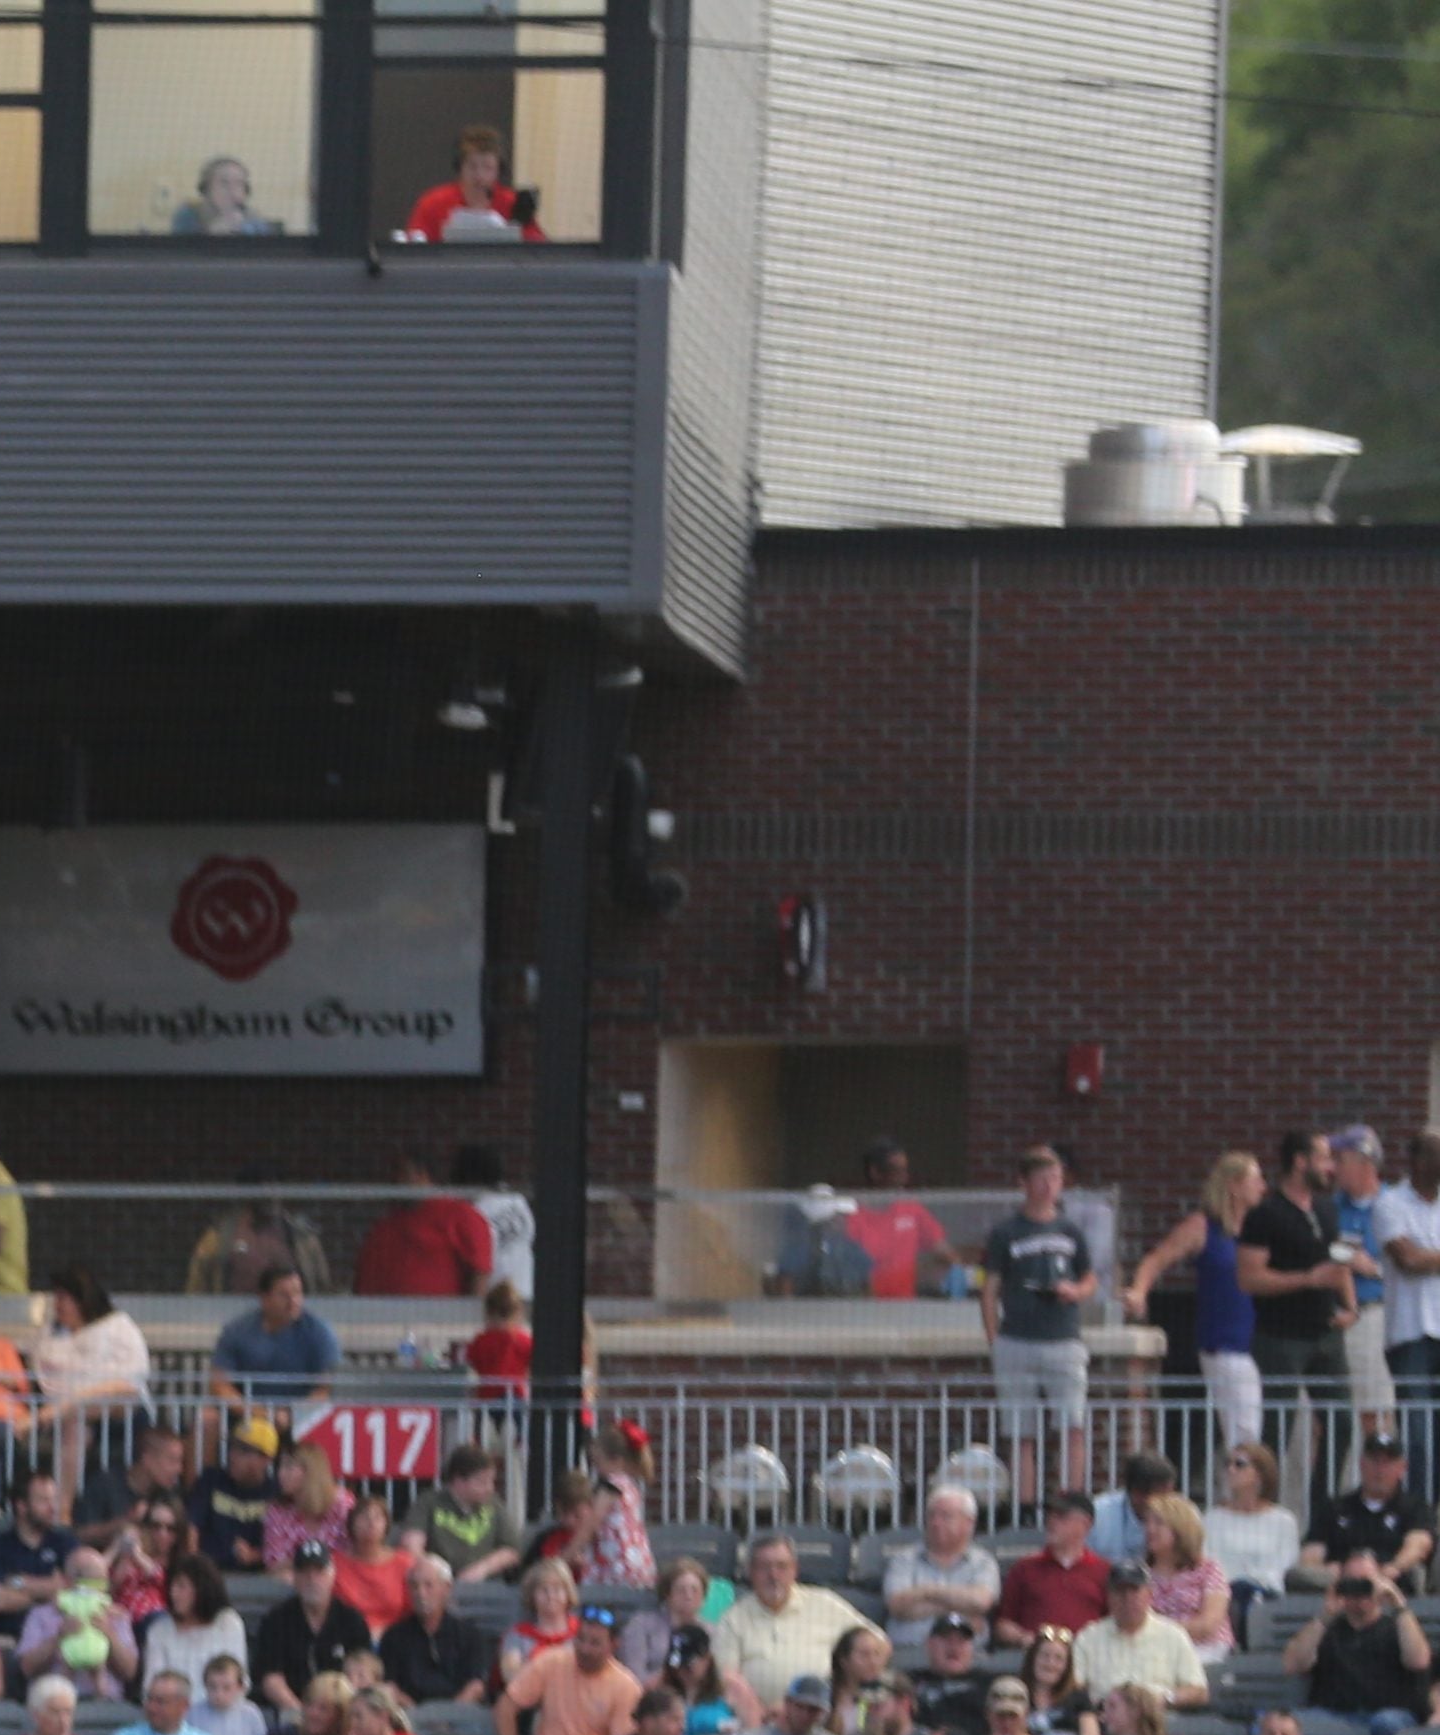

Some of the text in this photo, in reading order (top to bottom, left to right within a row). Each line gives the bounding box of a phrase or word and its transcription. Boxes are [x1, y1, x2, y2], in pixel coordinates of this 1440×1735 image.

[10, 995, 456, 1046] Walsingham Group
[332, 1409, 433, 1476] 117
